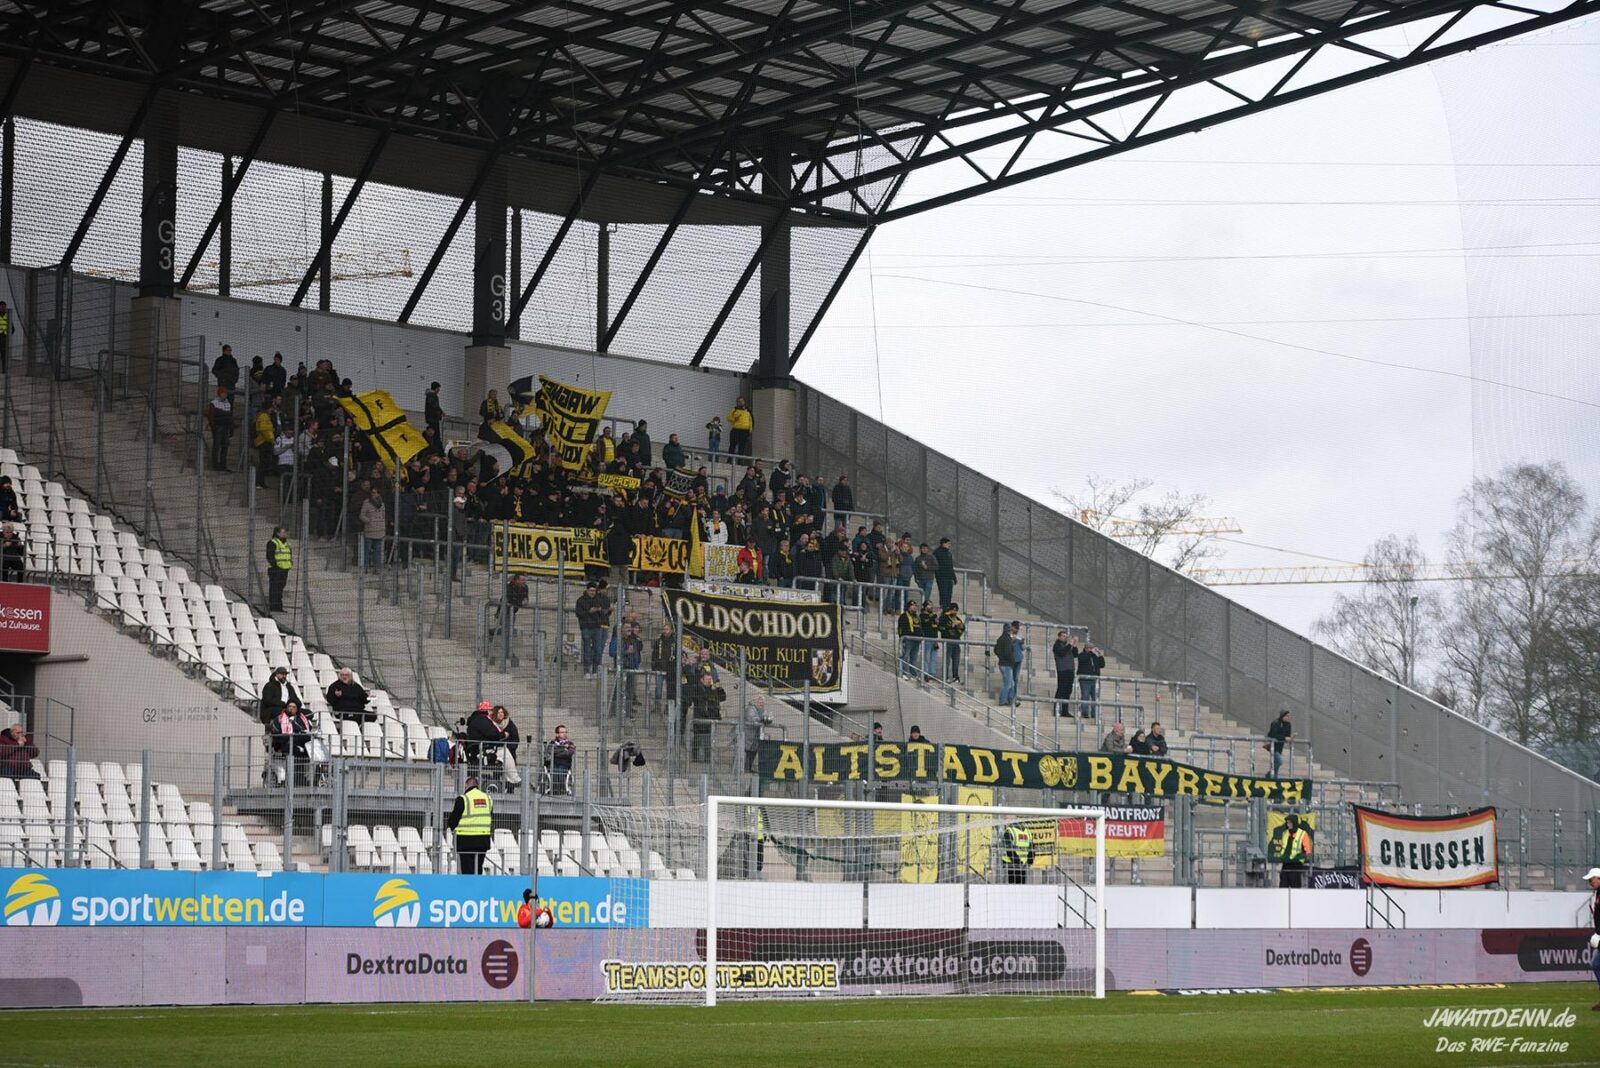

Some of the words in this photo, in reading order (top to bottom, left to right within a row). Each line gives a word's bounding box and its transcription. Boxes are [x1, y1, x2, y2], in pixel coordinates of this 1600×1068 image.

[574, 528, 593, 538] USK
[675, 597, 833, 639] OLDSCHDOD
[776, 648, 808, 664] KULT
[725, 661, 789, 679] BAREUTH
[142, 707, 157, 723] G2
[773, 743, 1029, 786] ALTSTADT
[1087, 756, 1304, 806] BAYREUTH
[1065, 803, 1162, 821] ADTFRONT
[1085, 822, 1148, 838] BREUTH
[1380, 835, 1486, 871] CREUSSEN
[71, 890, 305, 926] sportwetten.de
[429, 894, 627, 927] sportwtten.de
[347, 952, 468, 975] DextraData
[785, 948, 1038, 977] .dextradaa.com
[1265, 948, 1342, 966] DextraData
[1540, 941, 1591, 965] www.d
